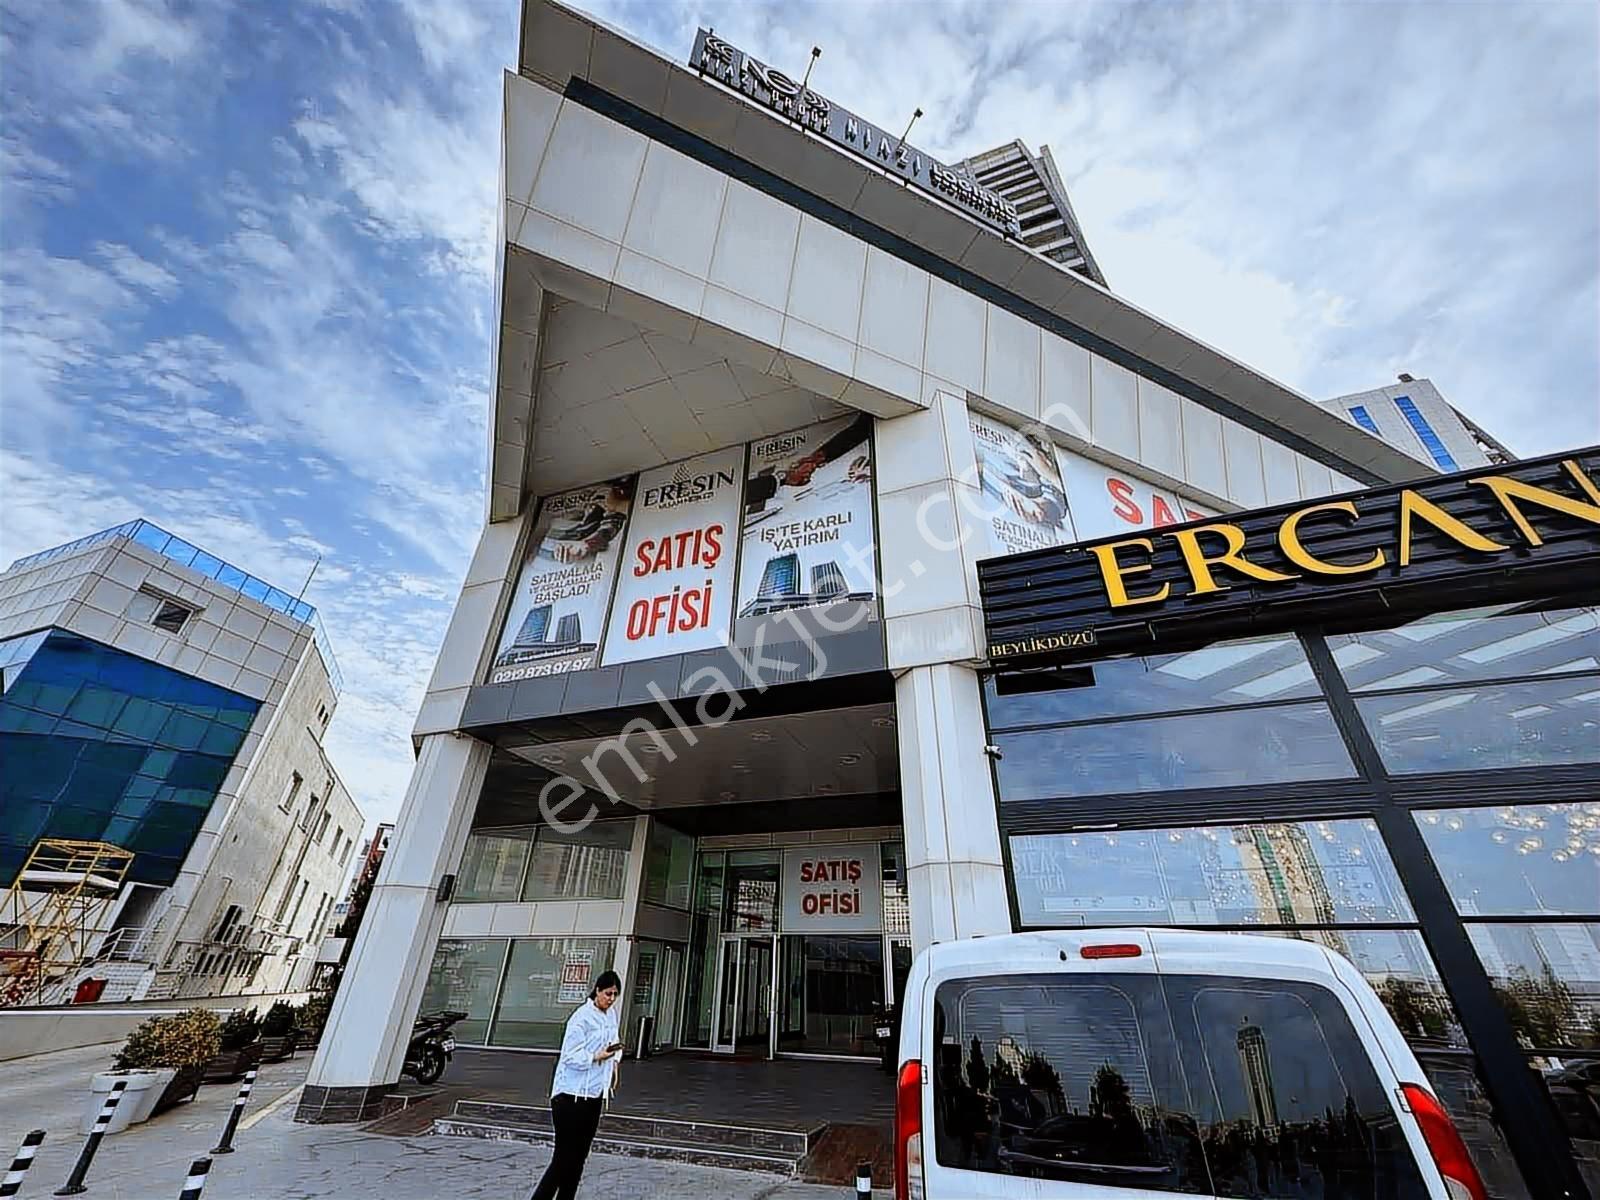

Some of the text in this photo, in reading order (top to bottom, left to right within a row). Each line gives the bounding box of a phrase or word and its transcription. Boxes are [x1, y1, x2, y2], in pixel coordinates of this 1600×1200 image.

[847, 117, 921, 171] NIAZI
[644, 466, 735, 508] ERESIN
[774, 527, 839, 552] YATIRIM
[803, 511, 852, 533] KARLI
[1087, 459, 1600, 609] ERCAN
[633, 524, 724, 578] SATIŞ
[626, 578, 713, 642] OFİSİ
[991, 629, 1094, 657] BEYLİKDÜZÜ
[800, 860, 862, 885] SATIŞ
[802, 888, 860, 915] OFİSİ
